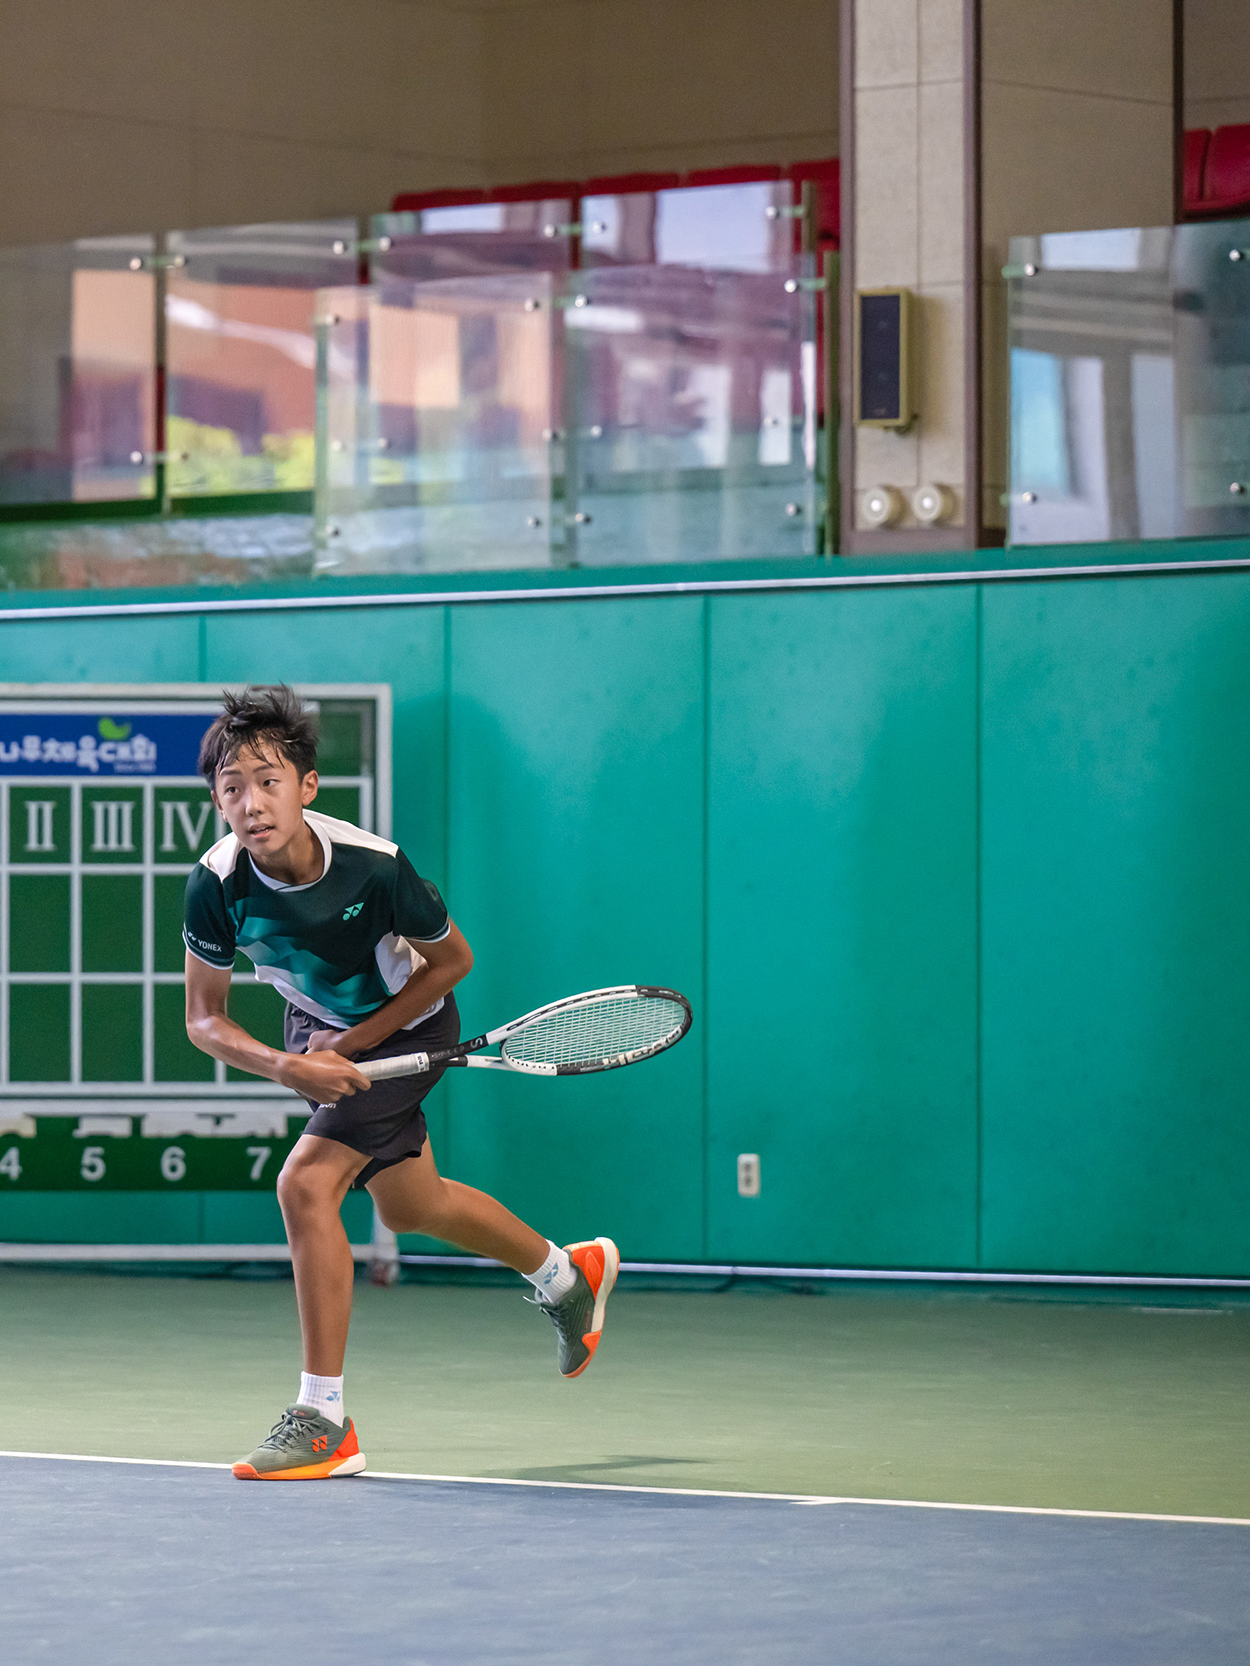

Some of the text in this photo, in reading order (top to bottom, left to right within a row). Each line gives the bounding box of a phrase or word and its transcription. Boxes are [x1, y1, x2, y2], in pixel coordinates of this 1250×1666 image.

[197, 939, 222, 952] YONEX
[80, 1147, 106, 1181] 5
[160, 1147, 186, 1181] 6
[247, 1147, 272, 1181] 7
